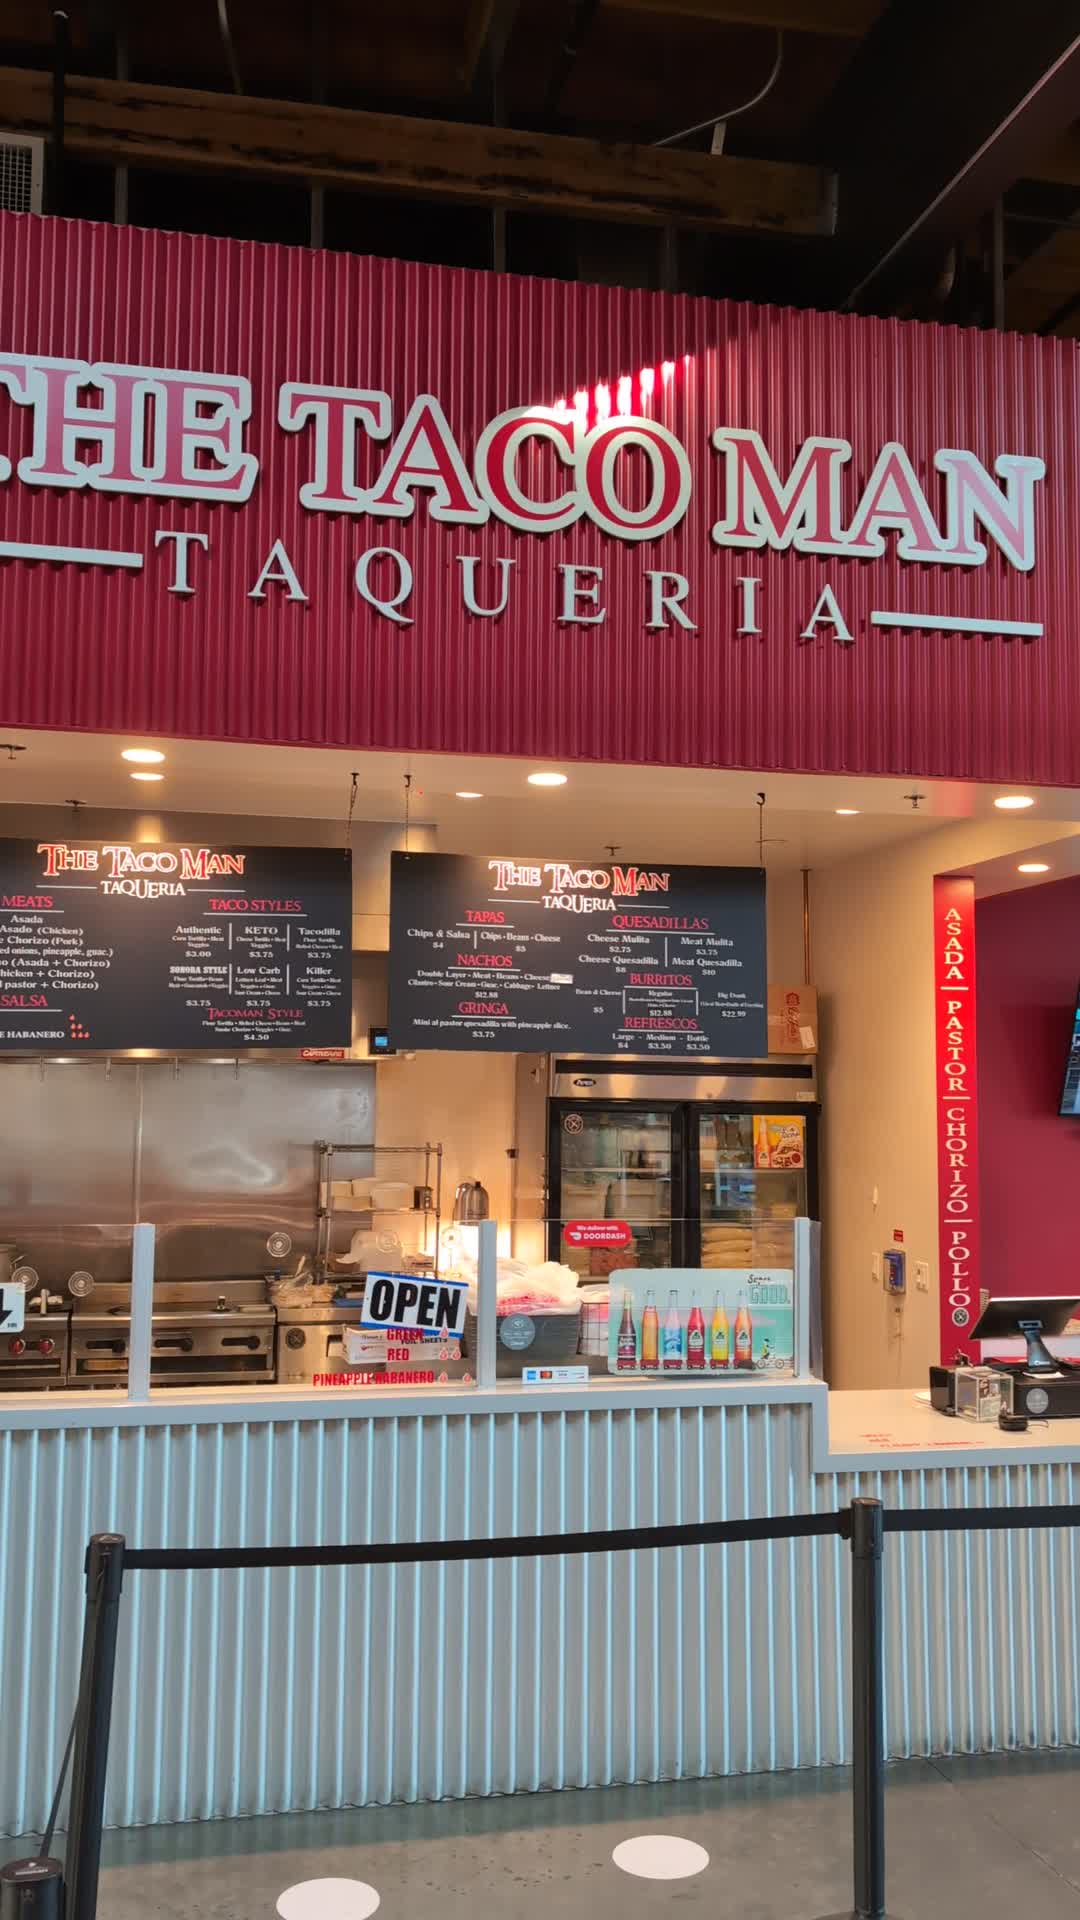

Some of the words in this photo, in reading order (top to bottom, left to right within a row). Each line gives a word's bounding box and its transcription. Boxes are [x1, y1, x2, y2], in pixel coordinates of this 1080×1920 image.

[278, 382, 692, 540] TACO
[713, 429, 1044, 571] MAN
[155, 532, 853, 642] TAQUERIA
[36, 843, 98, 876] THE
[102, 846, 177, 878] TACO
[180, 848, 245, 880] MAN
[488, 861, 542, 891] THE
[544, 863, 611, 894] TACO
[612, 866, 670, 896] MAN
[100, 879, 186, 899] TAQUERIA
[2, 895, 53, 908] MEATS
[208, 899, 249, 912] TACO
[251, 900, 302, 913] STYLES
[542, 894, 616, 913] TAQUERIA
[10, 915, 43, 924] Asada
[465, 910, 505, 923] TAPAS
[611, 914, 710, 930] QUESADILLAS
[37, 927, 83, 936] (Chicken)
[175, 926, 222, 934] Authentic
[244, 926, 278, 935] KETO
[298, 927, 341, 936] Tacodilla
[407, 929, 433, 938] Chips
[446, 930, 470, 939] Salsa
[480, 931, 502, 942] Chips
[534, 934, 561, 942] Cheese
[7, 936, 49, 946] Chorizo
[51, 938, 83, 947] (Pork)
[587, 934, 620, 944] Cheese
[622, 935, 650, 944] Mulita
[681, 936, 704, 946] Meat
[706, 937, 734, 946] Mulita
[943, 907, 964, 981] ASADA
[11, 958, 49, 969] (Asada
[63, 959, 110, 970] Chorizo)
[457, 954, 513, 968] NACHOS
[578, 955, 611, 964] Cheese
[672, 957, 694, 967] Meat
[47, 969, 95, 981] Chorizo)
[203, 967, 228, 975] STYLE
[237, 967, 256, 976] Low
[258, 967, 280, 976] Carb
[306, 967, 333, 976] Killer
[4, 980, 38, 992] pastor
[52, 980, 99, 992] Chorizo)
[630, 973, 693, 986] BURRITOS
[1, 994, 48, 1007] SALSA
[458, 1001, 509, 1015] GRINGA
[624, 1017, 698, 1030] REFRESCOS
[7, 1031, 64, 1041] HABANERO
[945, 1000, 969, 1093] PASTOR
[946, 1108, 970, 1215] CHORIZO
[948, 1231, 972, 1308] POLLO
[369, 1279, 461, 1329] OPEN
[386, 1328, 424, 1341] GREEN
[387, 1348, 410, 1361] RED
[312, 1372, 373, 1387] PINEAPPLE
[375, 1371, 435, 1385] HABANERO
